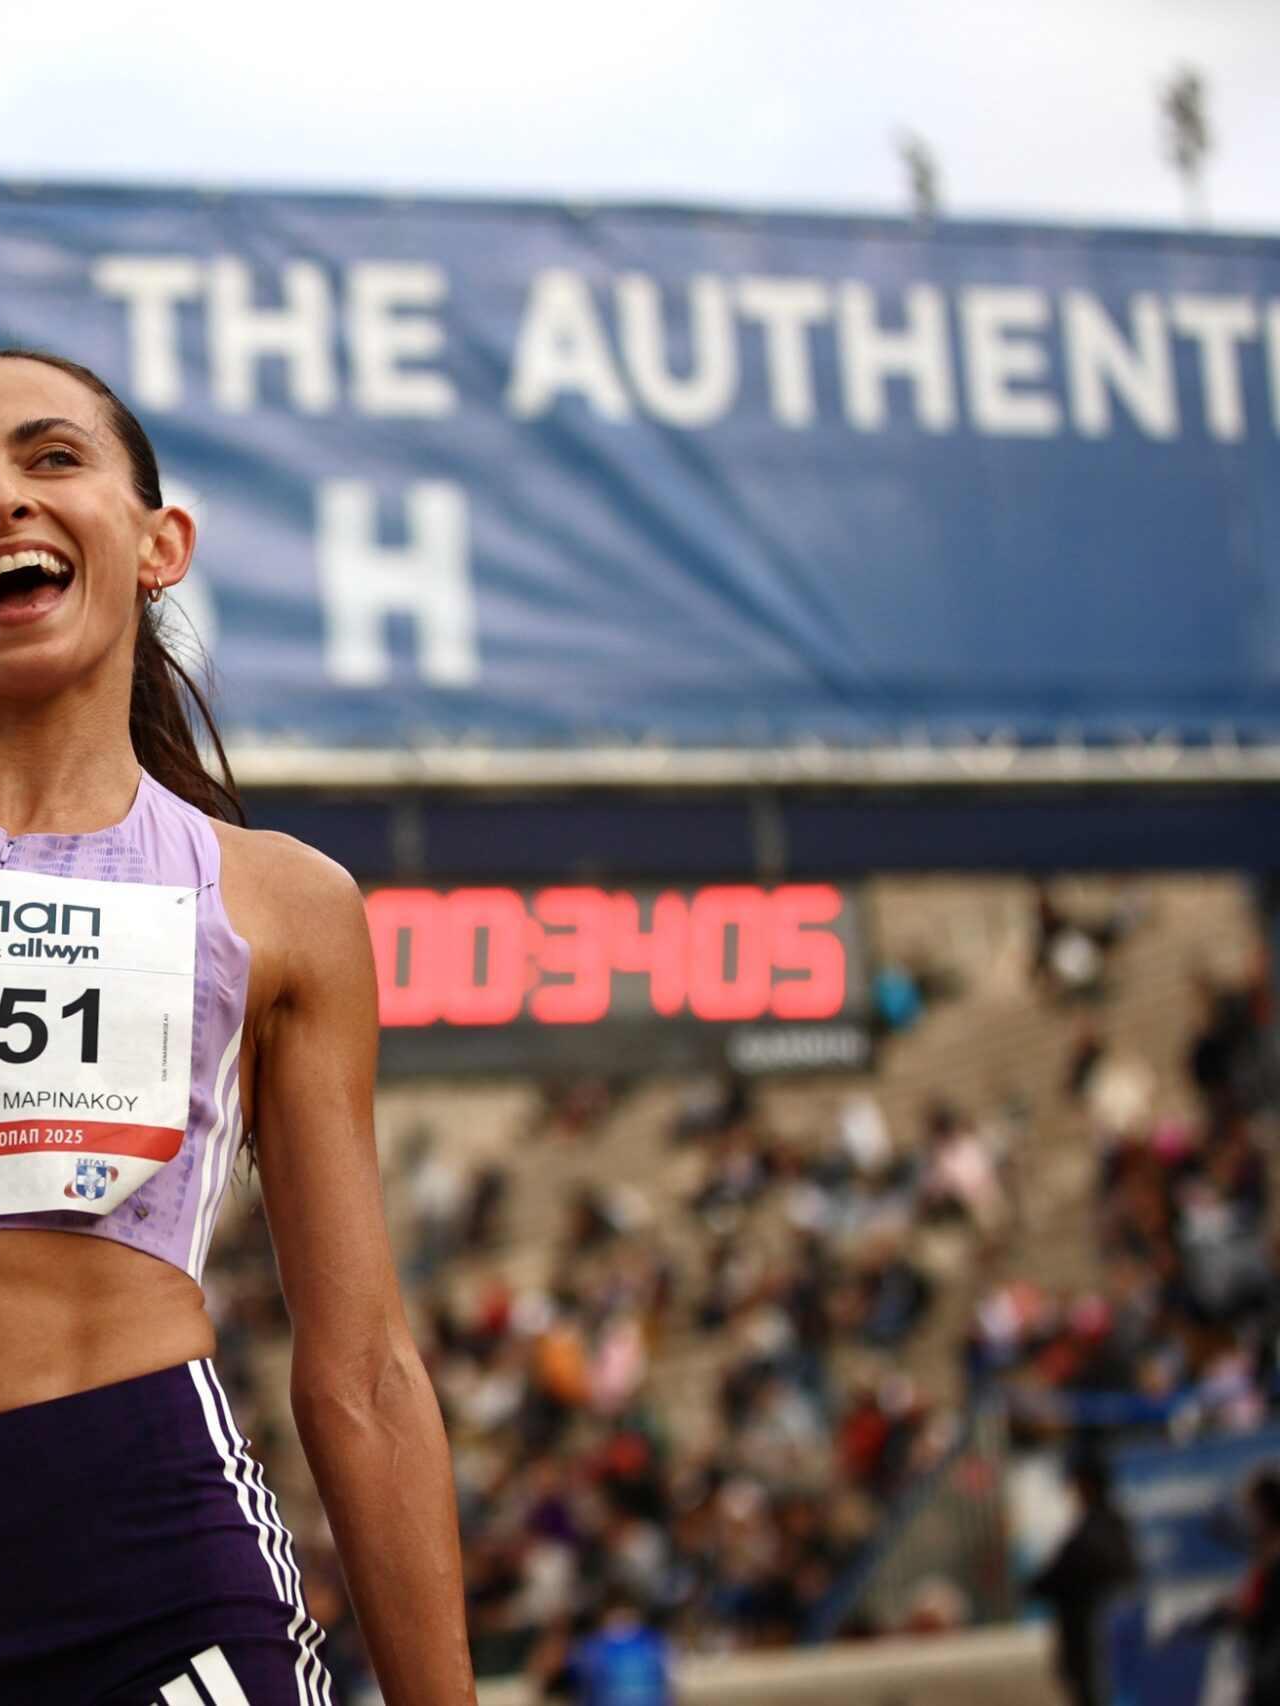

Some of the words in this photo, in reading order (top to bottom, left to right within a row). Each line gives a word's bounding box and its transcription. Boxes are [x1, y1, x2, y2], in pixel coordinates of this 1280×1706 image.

[92, 254, 457, 420] THE
[8, 938, 99, 964] allwyn
[3, 1091, 139, 1112] ΜΑΡΙΝΑΚΟΥ
[44, 1129, 84, 1144] 2025
